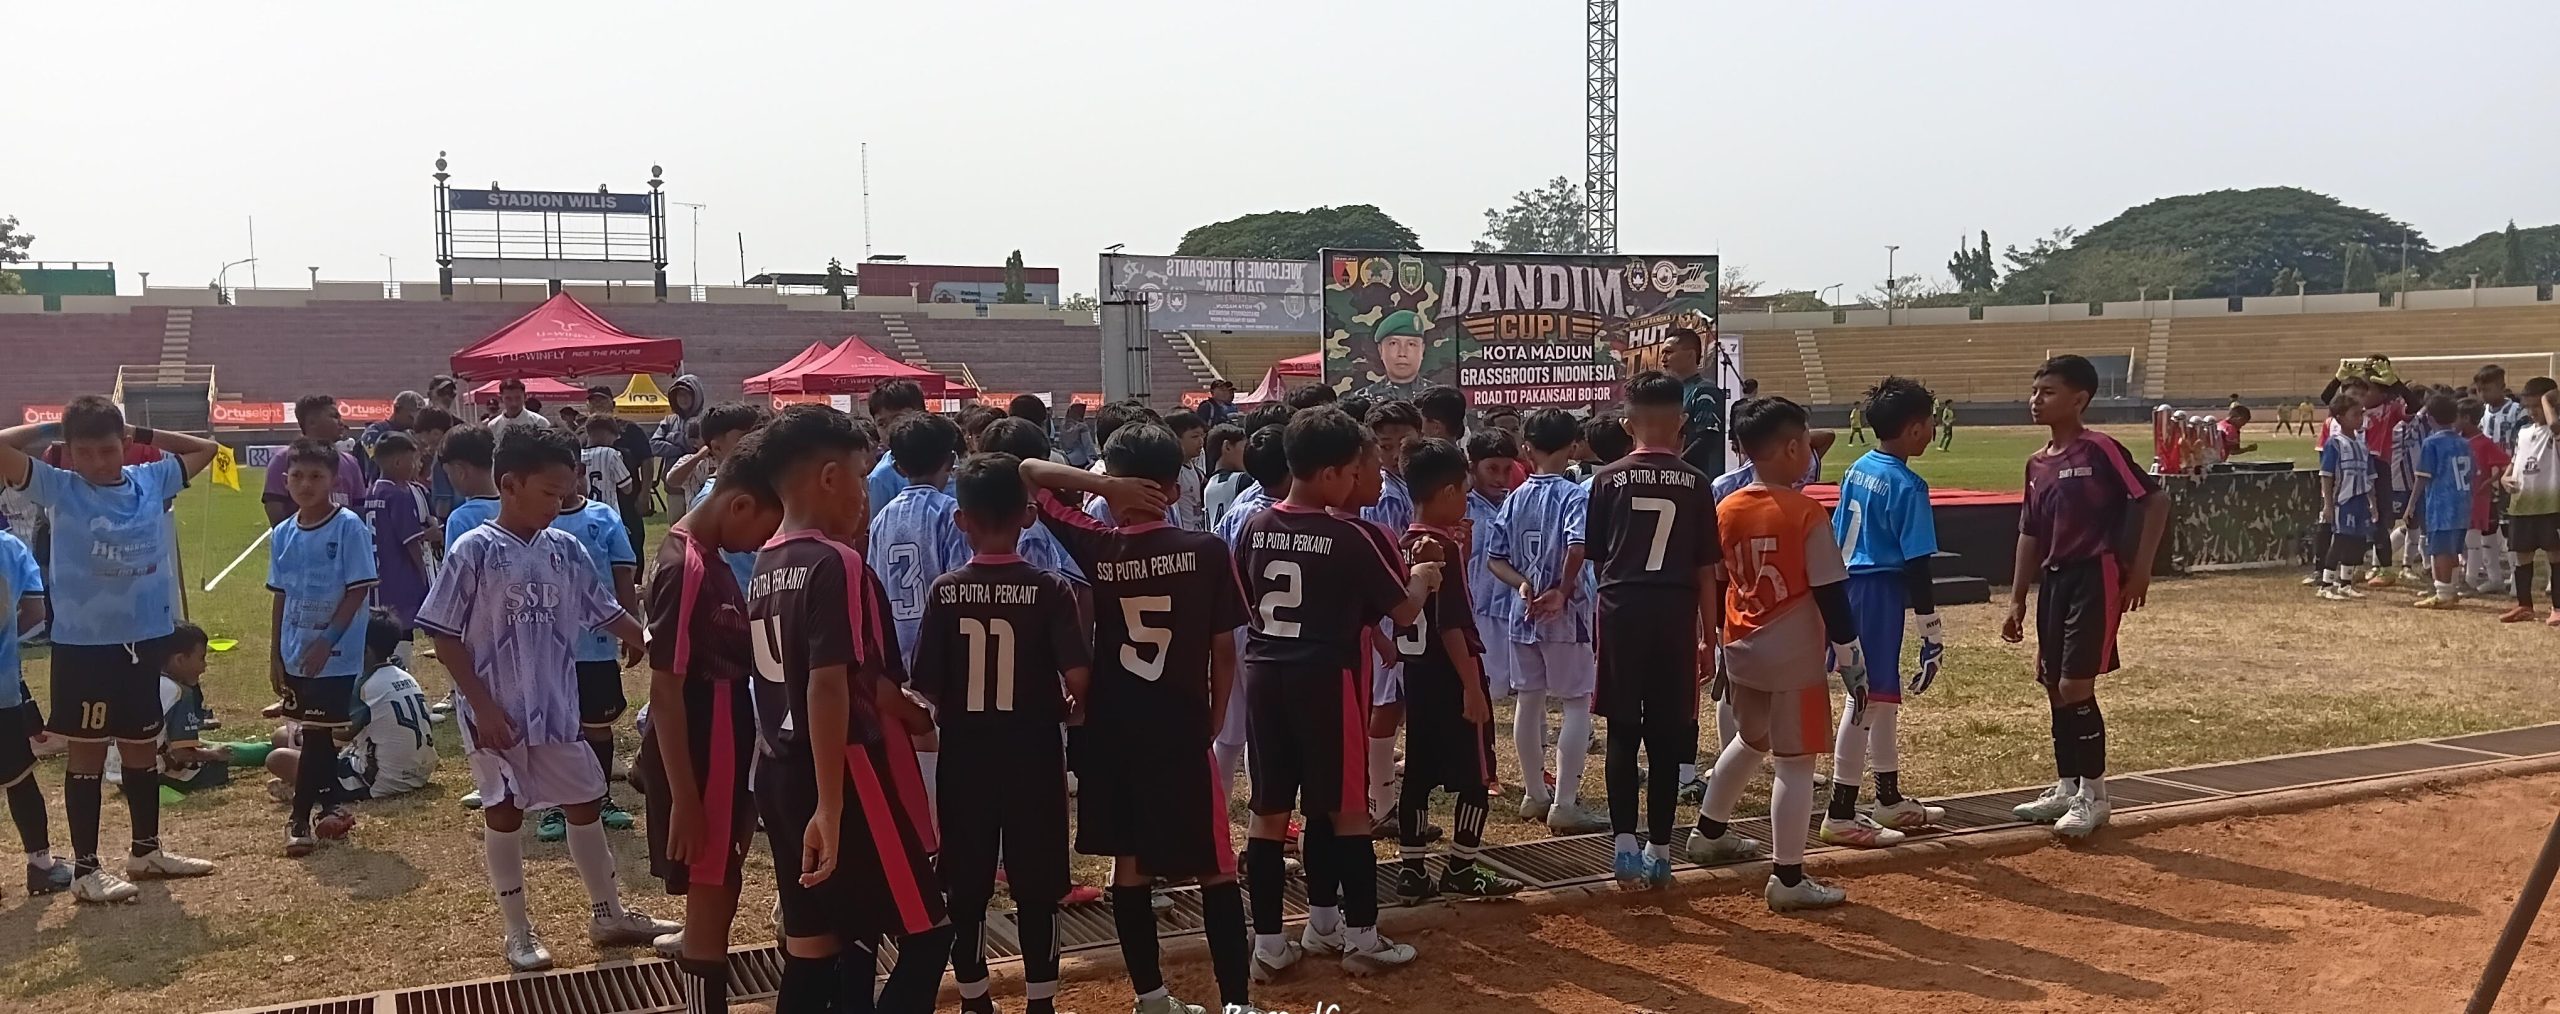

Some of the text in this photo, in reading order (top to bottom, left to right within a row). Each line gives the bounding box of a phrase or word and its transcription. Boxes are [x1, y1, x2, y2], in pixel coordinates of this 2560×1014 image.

[488, 193, 617, 209] STADION WILIS
[1435, 264, 1630, 320] DANDIM
[1500, 314, 1554, 340] CUP
[1628, 323, 1670, 349] HUT
[1483, 345, 1592, 360] KOTA MADIUN
[1460, 364, 1616, 386] GRASSGROOTS INDONESIA
[338, 401, 394, 417] Ortuseig
[1474, 387, 1610, 405] ROAD TO PAKANSARI BOGOR
[213, 404, 282, 420] Ortuseight
[1612, 469, 1696, 489] SSB PUTRA PERKANTI
[2452, 455, 2471, 491] 12
[1252, 531, 1333, 556] SSB PUTRA PERKANTI
[1631, 496, 1676, 572] 7
[1097, 552, 1196, 582] SSB PUTRA PERKANTI
[752, 577, 771, 600] PUTRA
[772, 567, 808, 594] PERKANTI
[888, 541, 926, 621] 3
[939, 585, 957, 605] SSB
[959, 584, 991, 604] PUTRA
[505, 581, 560, 610] SSB
[1259, 560, 1302, 638] 2
[1119, 595, 1172, 681] 5
[959, 617, 1015, 711] 11
[81, 701, 107, 730] 18
